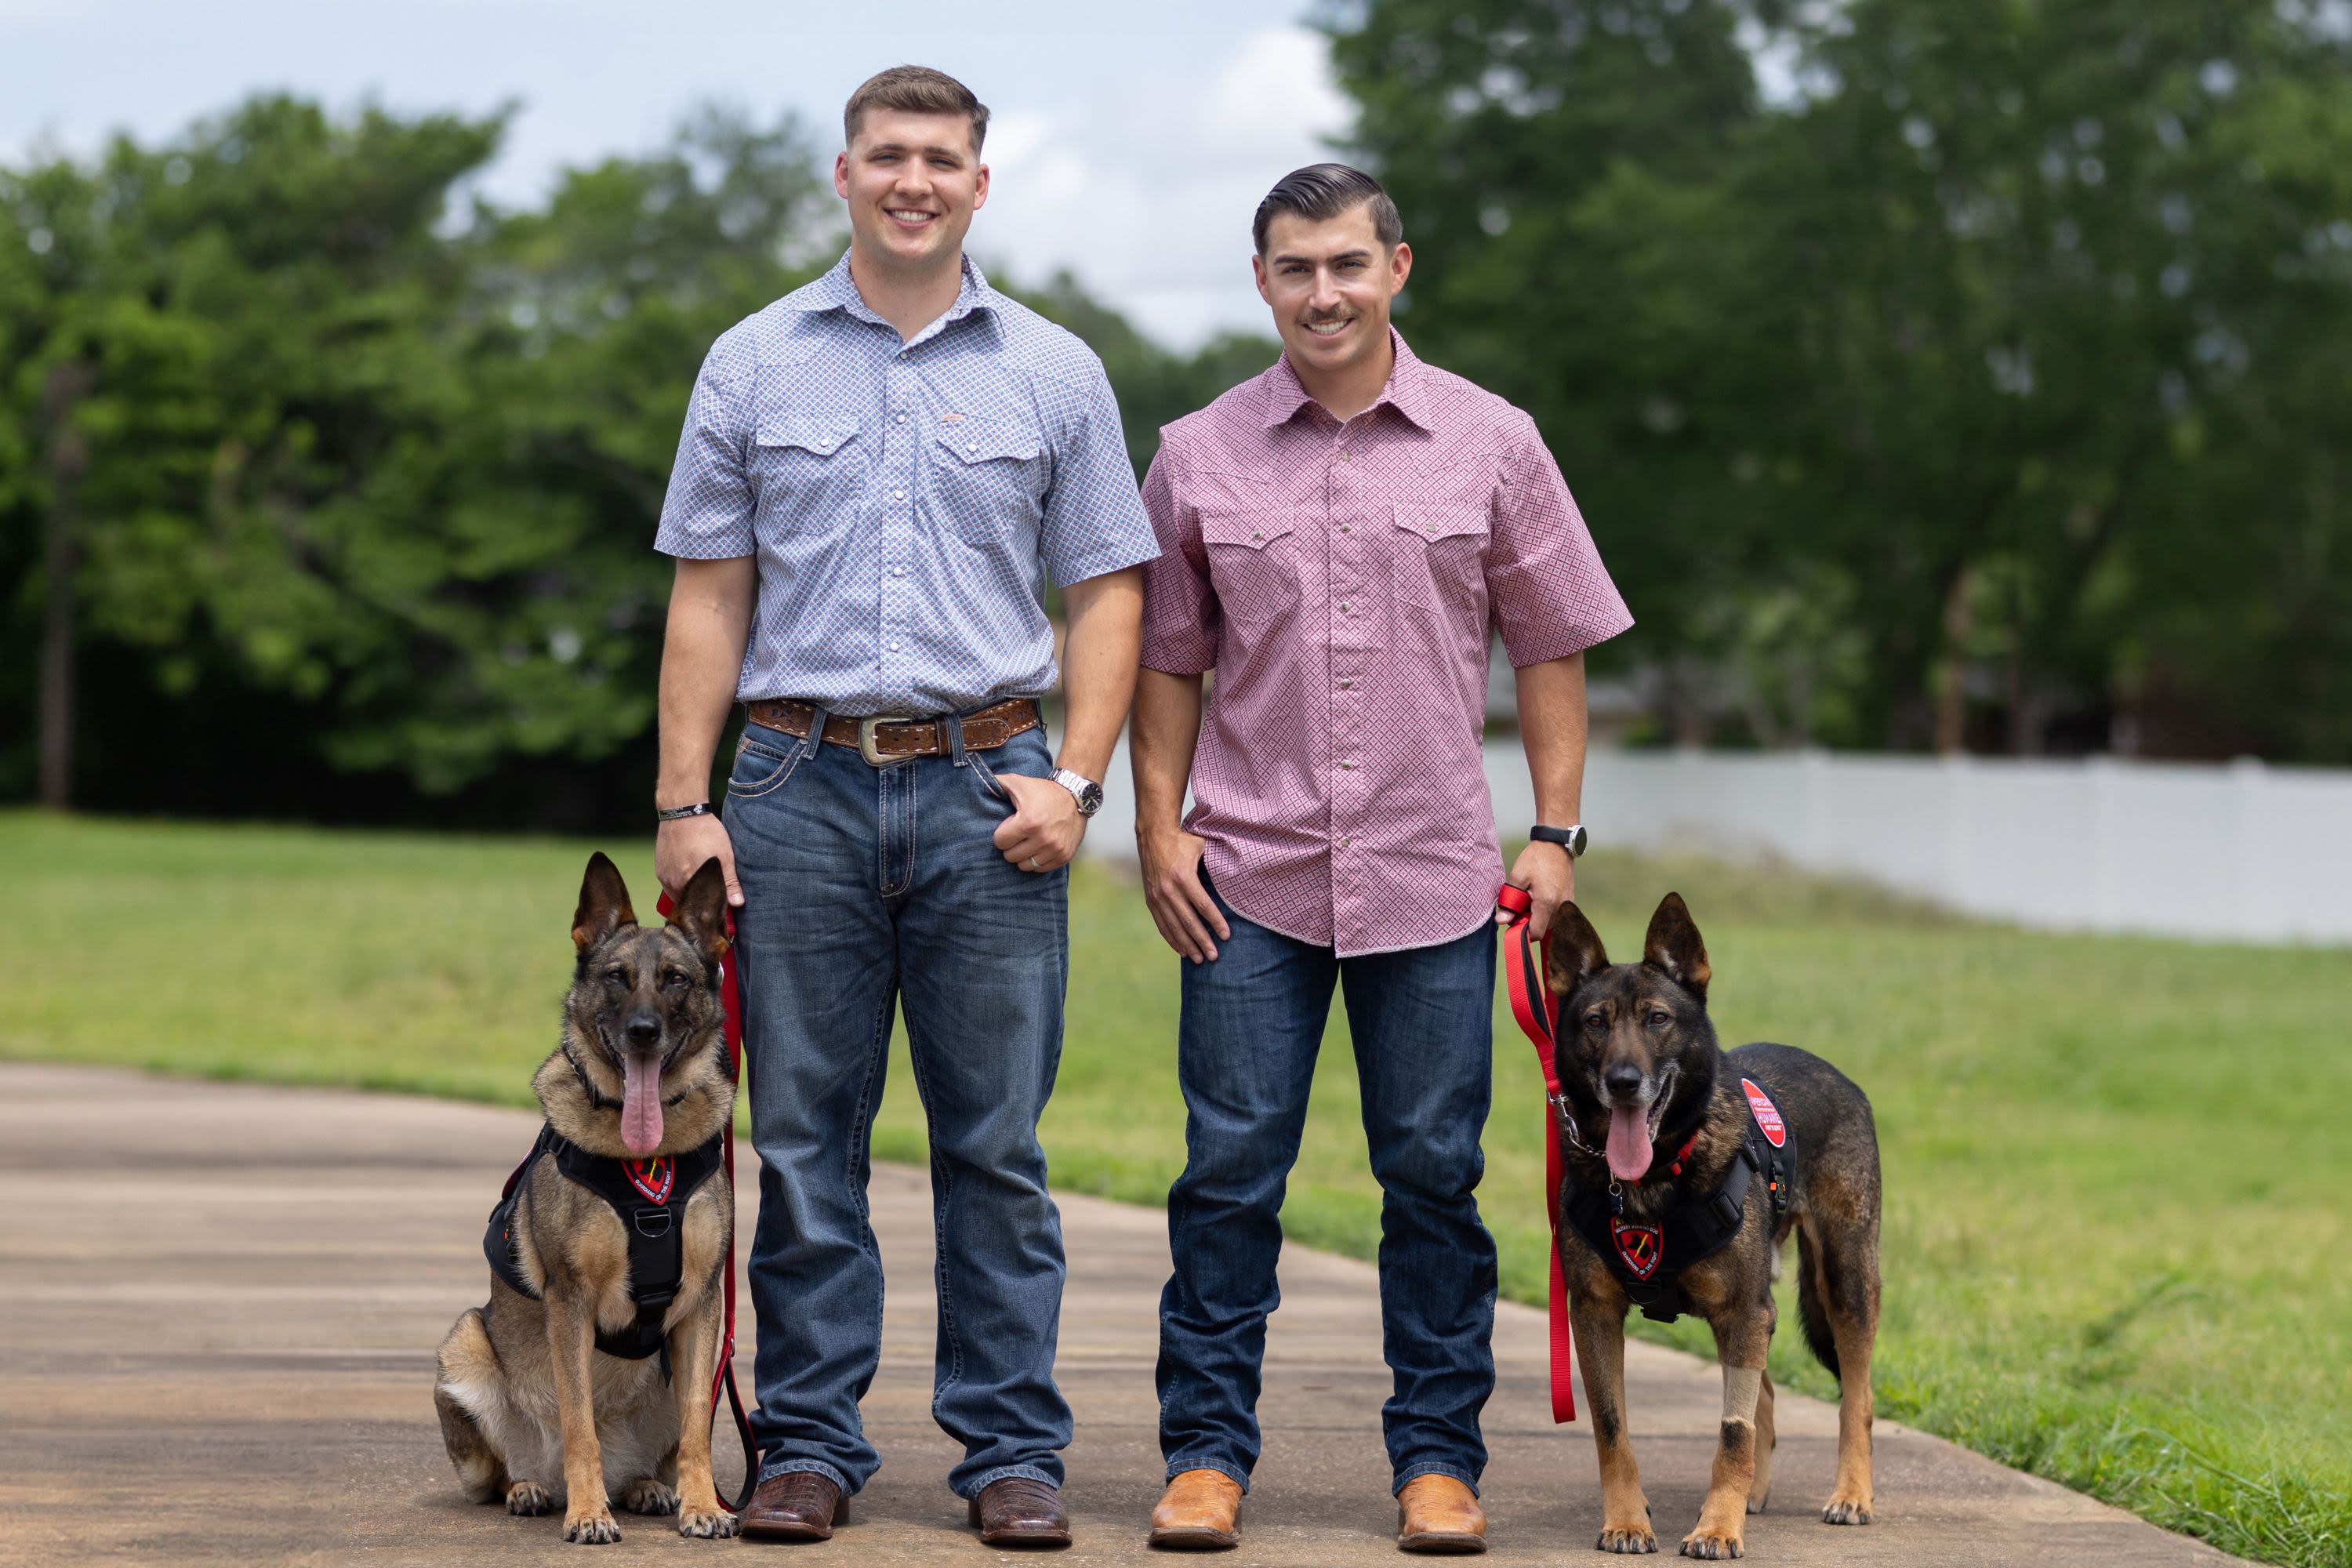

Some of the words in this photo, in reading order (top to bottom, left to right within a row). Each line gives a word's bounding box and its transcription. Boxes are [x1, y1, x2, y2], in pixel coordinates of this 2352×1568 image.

[1757, 1112, 1782, 1123] HUMANE
[635, 1179, 655, 1197] GUARDIANS
[1622, 1251, 1639, 1271] GUARDIANS
